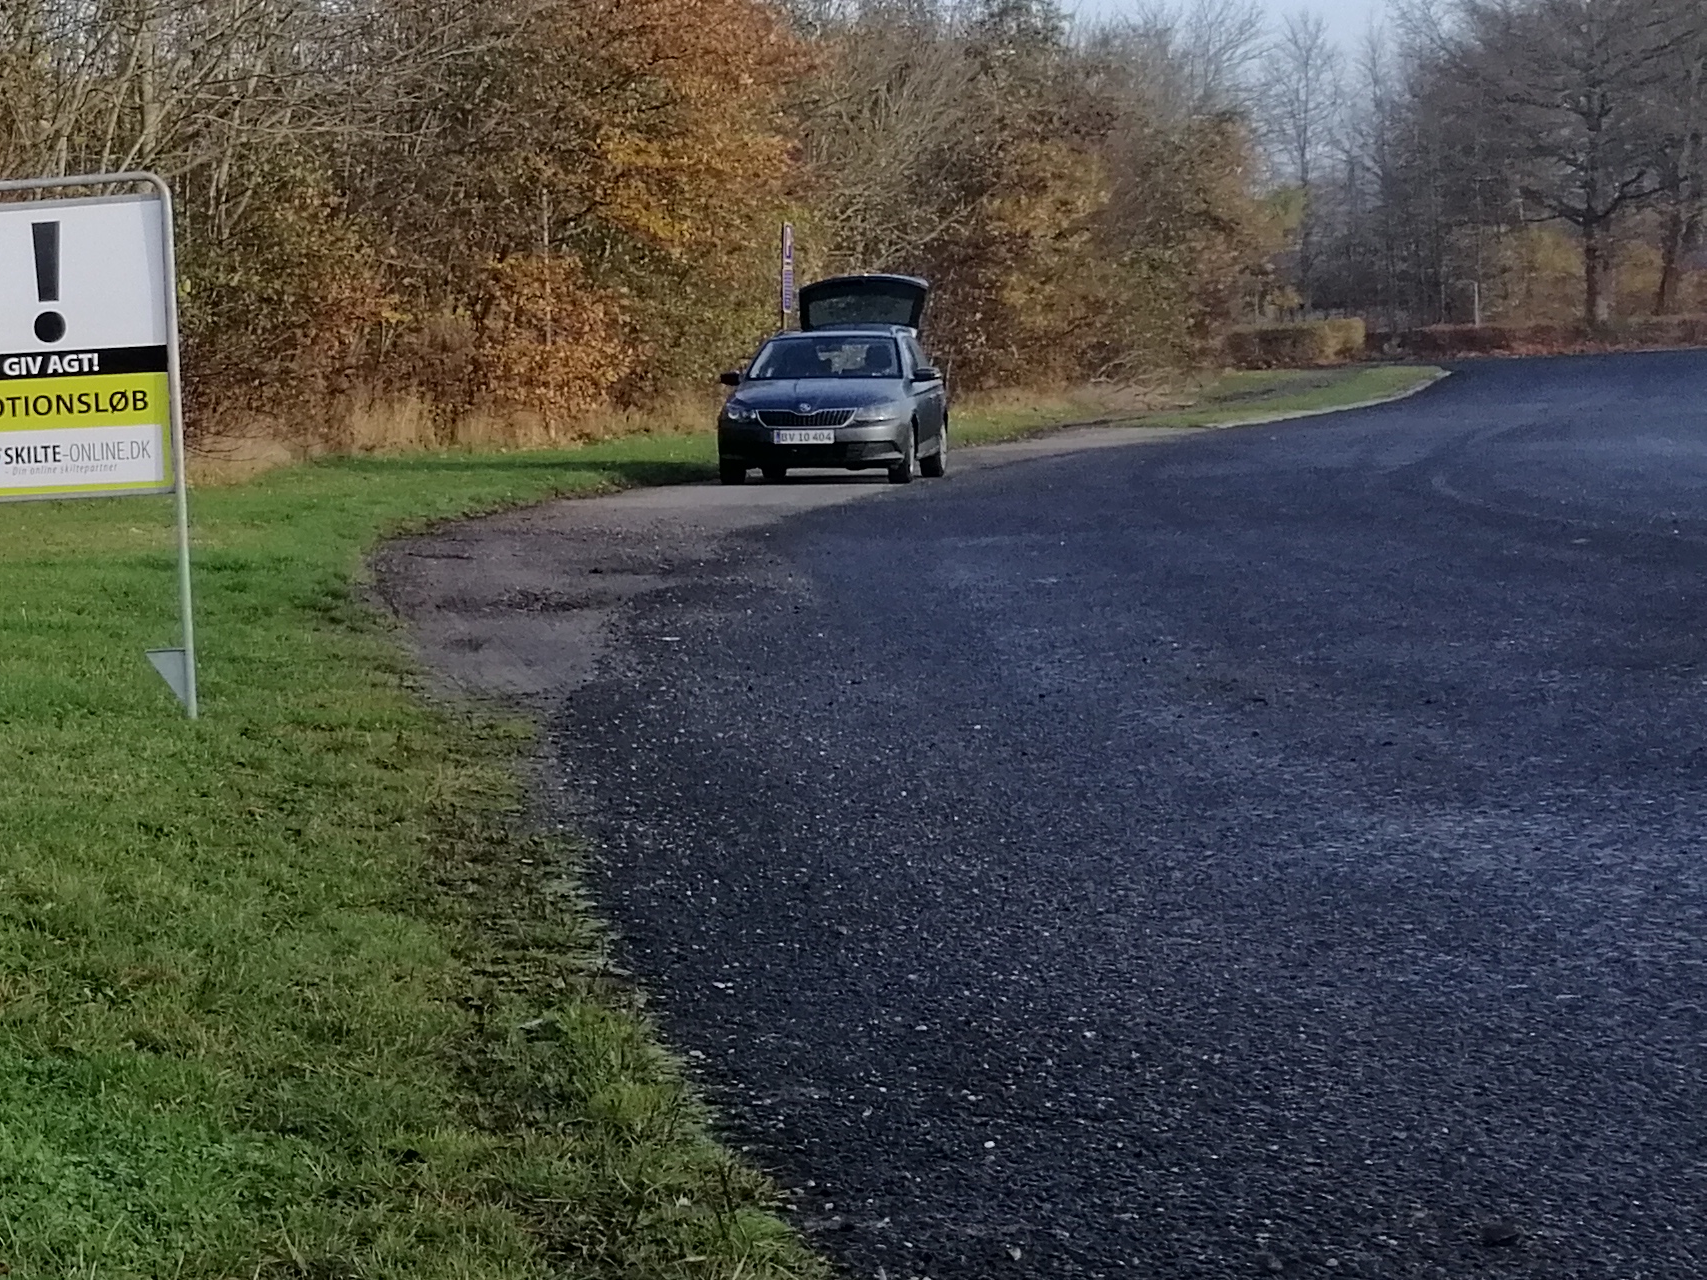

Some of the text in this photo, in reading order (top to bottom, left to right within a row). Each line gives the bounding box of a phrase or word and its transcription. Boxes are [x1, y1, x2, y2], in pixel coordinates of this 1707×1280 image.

[2, 352, 100, 377] GIV AGT!
[3, 439, 152, 466] SKILTE-ONLINE.DK
[29, 464, 58, 476] online
